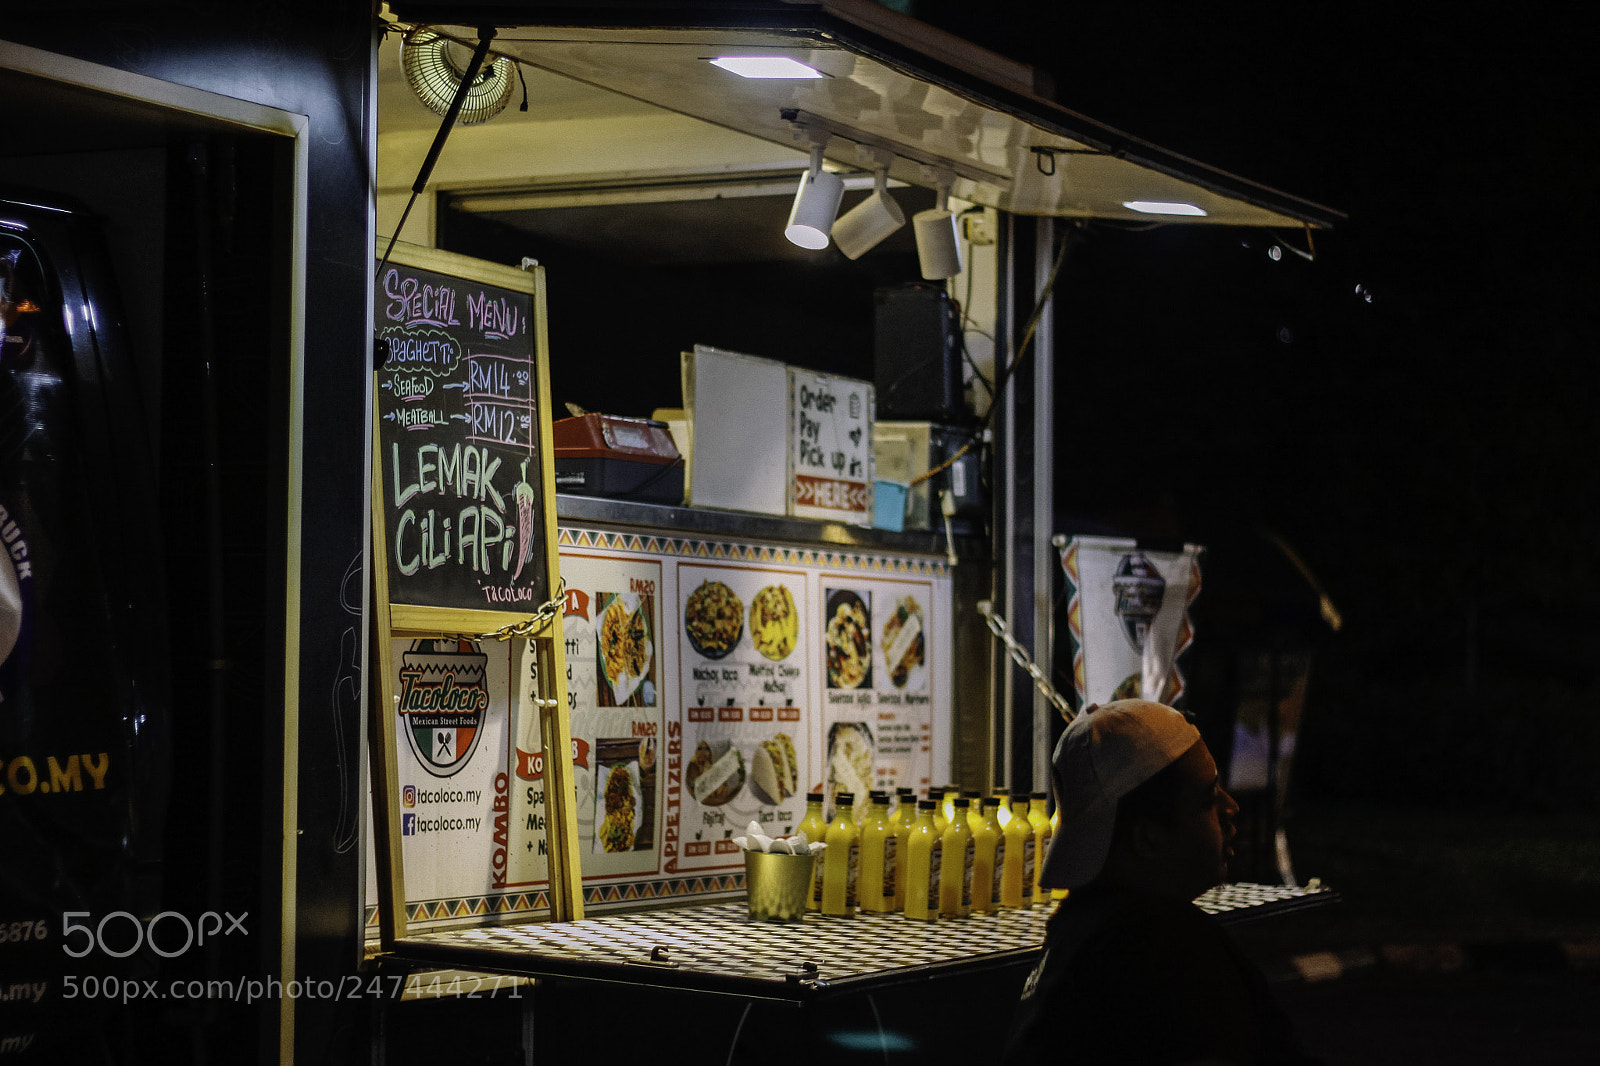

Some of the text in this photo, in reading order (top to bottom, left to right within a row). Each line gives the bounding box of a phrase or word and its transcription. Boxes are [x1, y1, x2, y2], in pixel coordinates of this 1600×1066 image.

[801, 384, 836, 413] Order
[396, 408, 449, 426] MEATBALL
[801, 411, 820, 443] Pay
[801, 439, 824, 467] Pick
[392, 442, 507, 514] LEMAK
[630, 578, 656, 594] RM20
[400, 671, 488, 713] Tacoloco
[412, 716, 478, 726] Mexican Street Foods
[632, 721, 658, 737] RM20
[0, 752, 110, 796] O.MY
[417, 787, 482, 805] tacoloco.my
[663, 720, 682, 875] APPETIZERS
[417, 815, 481, 834] tacoloco.my
[492, 772, 510, 889] KOMBO
